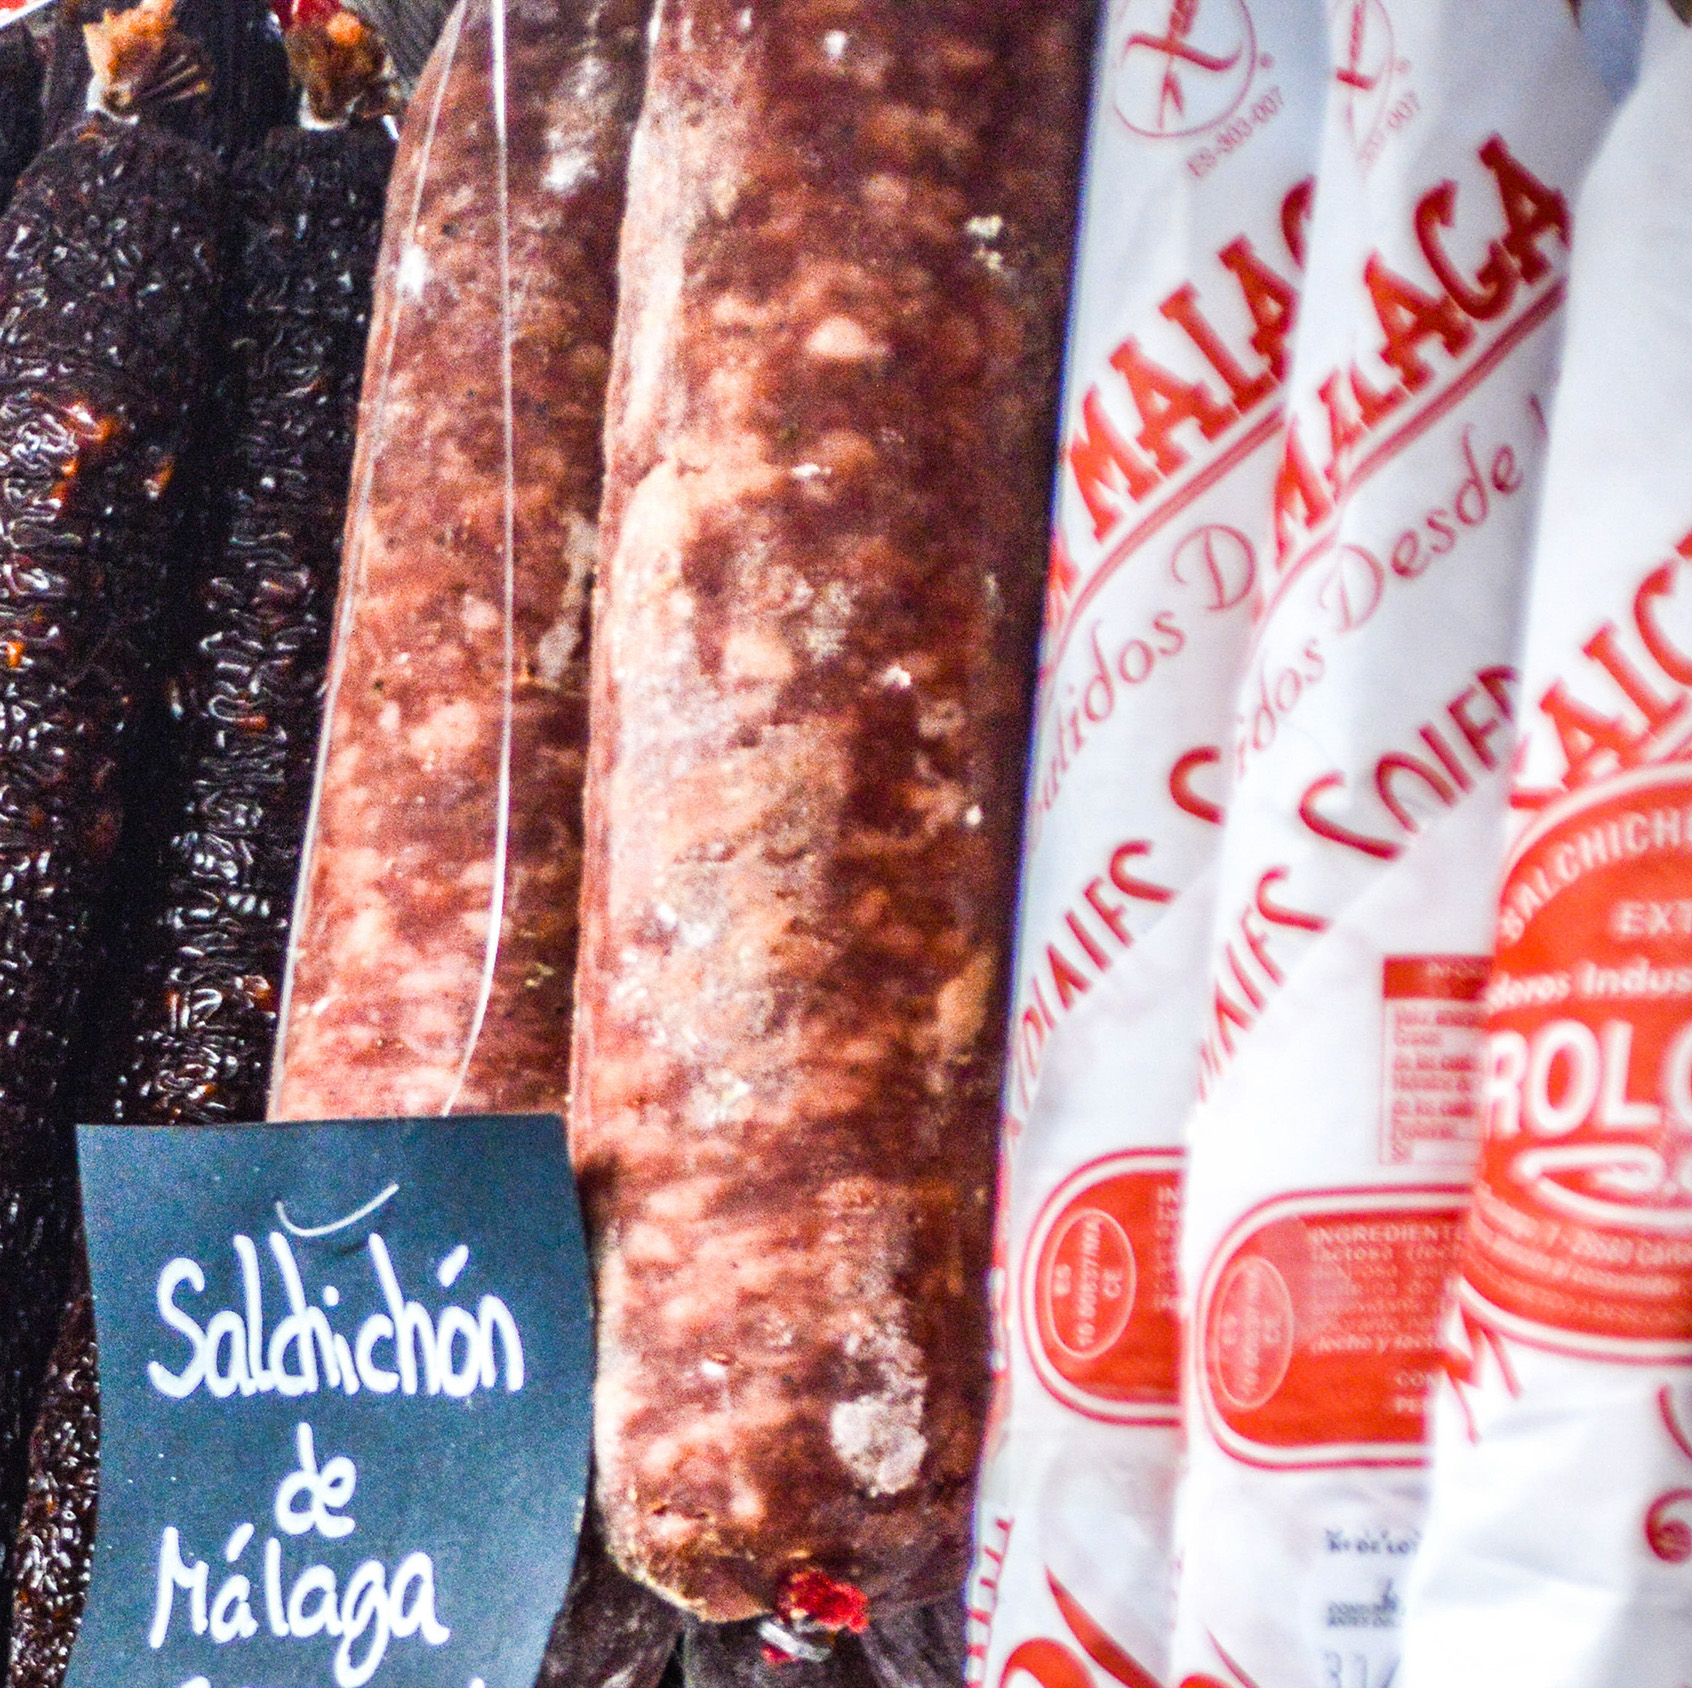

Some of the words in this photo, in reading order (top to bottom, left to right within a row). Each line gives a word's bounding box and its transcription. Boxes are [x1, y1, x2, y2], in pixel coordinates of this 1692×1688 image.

[1499, 807, 1692, 943] SALCHICH
[1580, 955, 1692, 998] Indus
[148, 1230, 525, 1399] Salchichón
[274, 1421, 357, 1539] de
